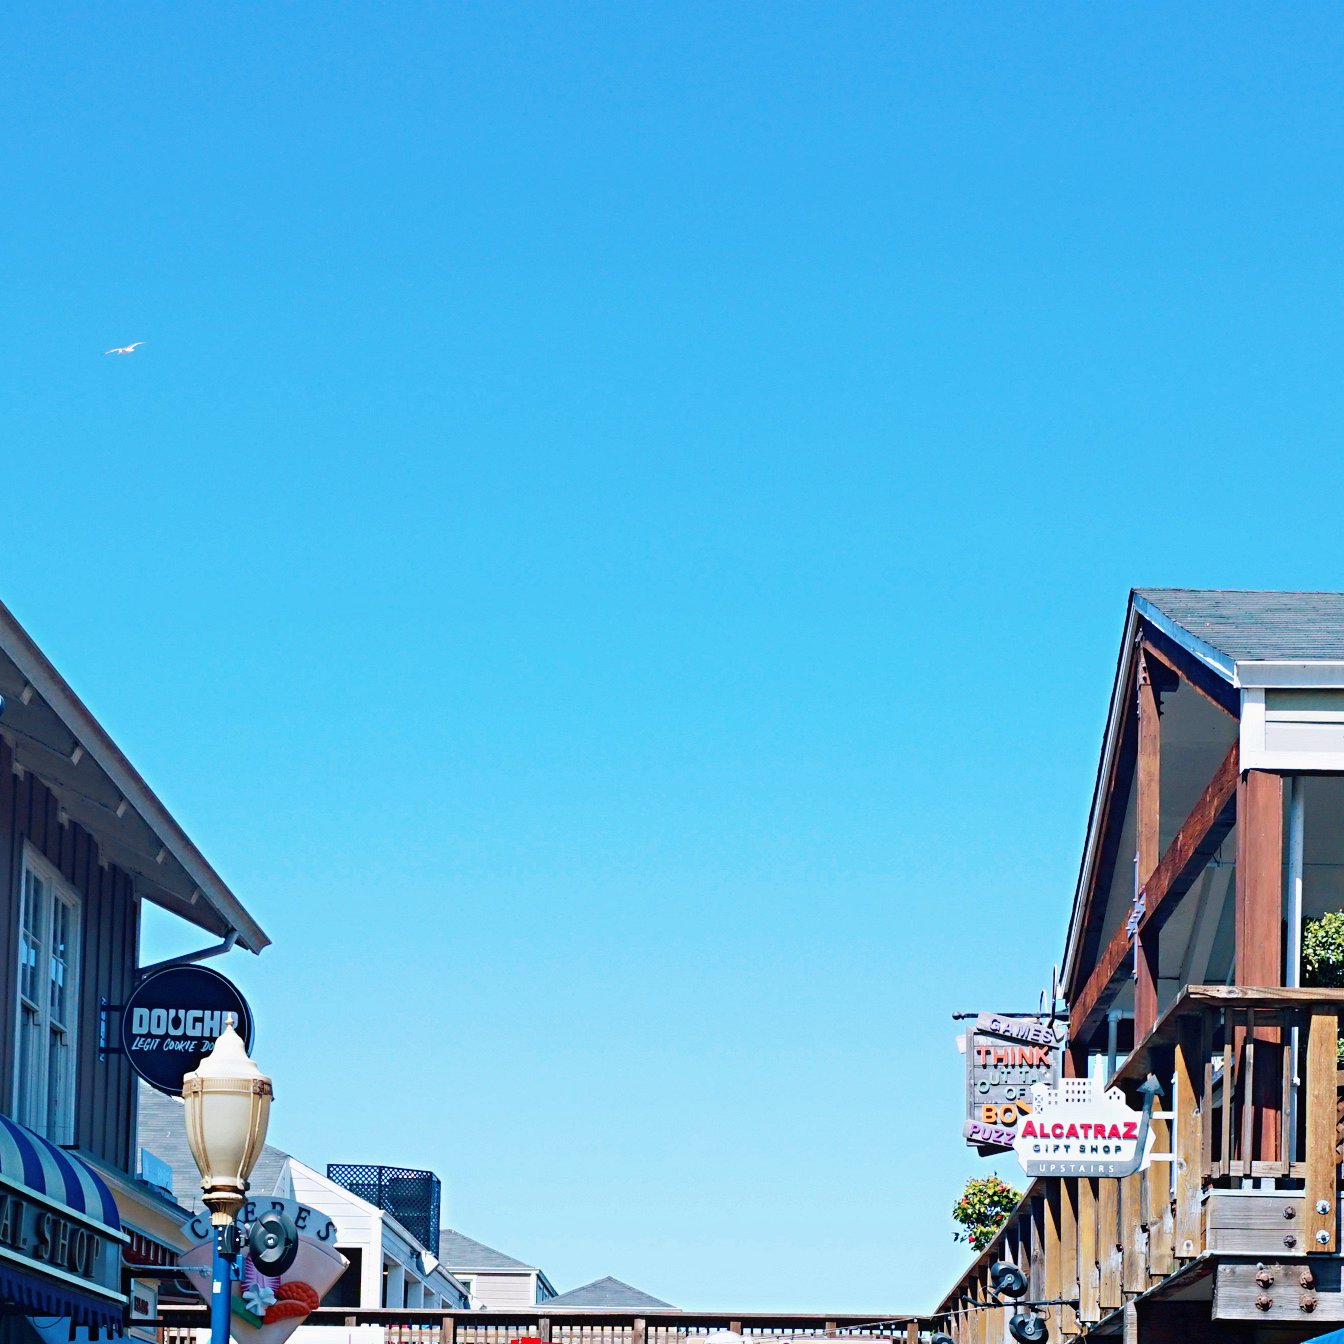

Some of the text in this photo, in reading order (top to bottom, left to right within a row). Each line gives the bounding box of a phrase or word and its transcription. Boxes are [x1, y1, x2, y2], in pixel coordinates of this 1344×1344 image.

[990, 1018, 1054, 1044] GAMES
[131, 1036, 162, 1052] LEGIT
[163, 1038, 198, 1053] COOKIE
[976, 1045, 1052, 1069] THINK
[977, 1068, 1011, 1095] OUT
[1003, 1085, 1027, 1102] OF
[970, 1123, 1016, 1147] PUZZ
[1021, 1120, 1138, 1141] ALCATRAZ
[1033, 1143, 1123, 1155] GIFT SHOP
[1039, 1164, 1115, 1173] UPSTAIRS
[36, 1212, 102, 1279] SHOP
